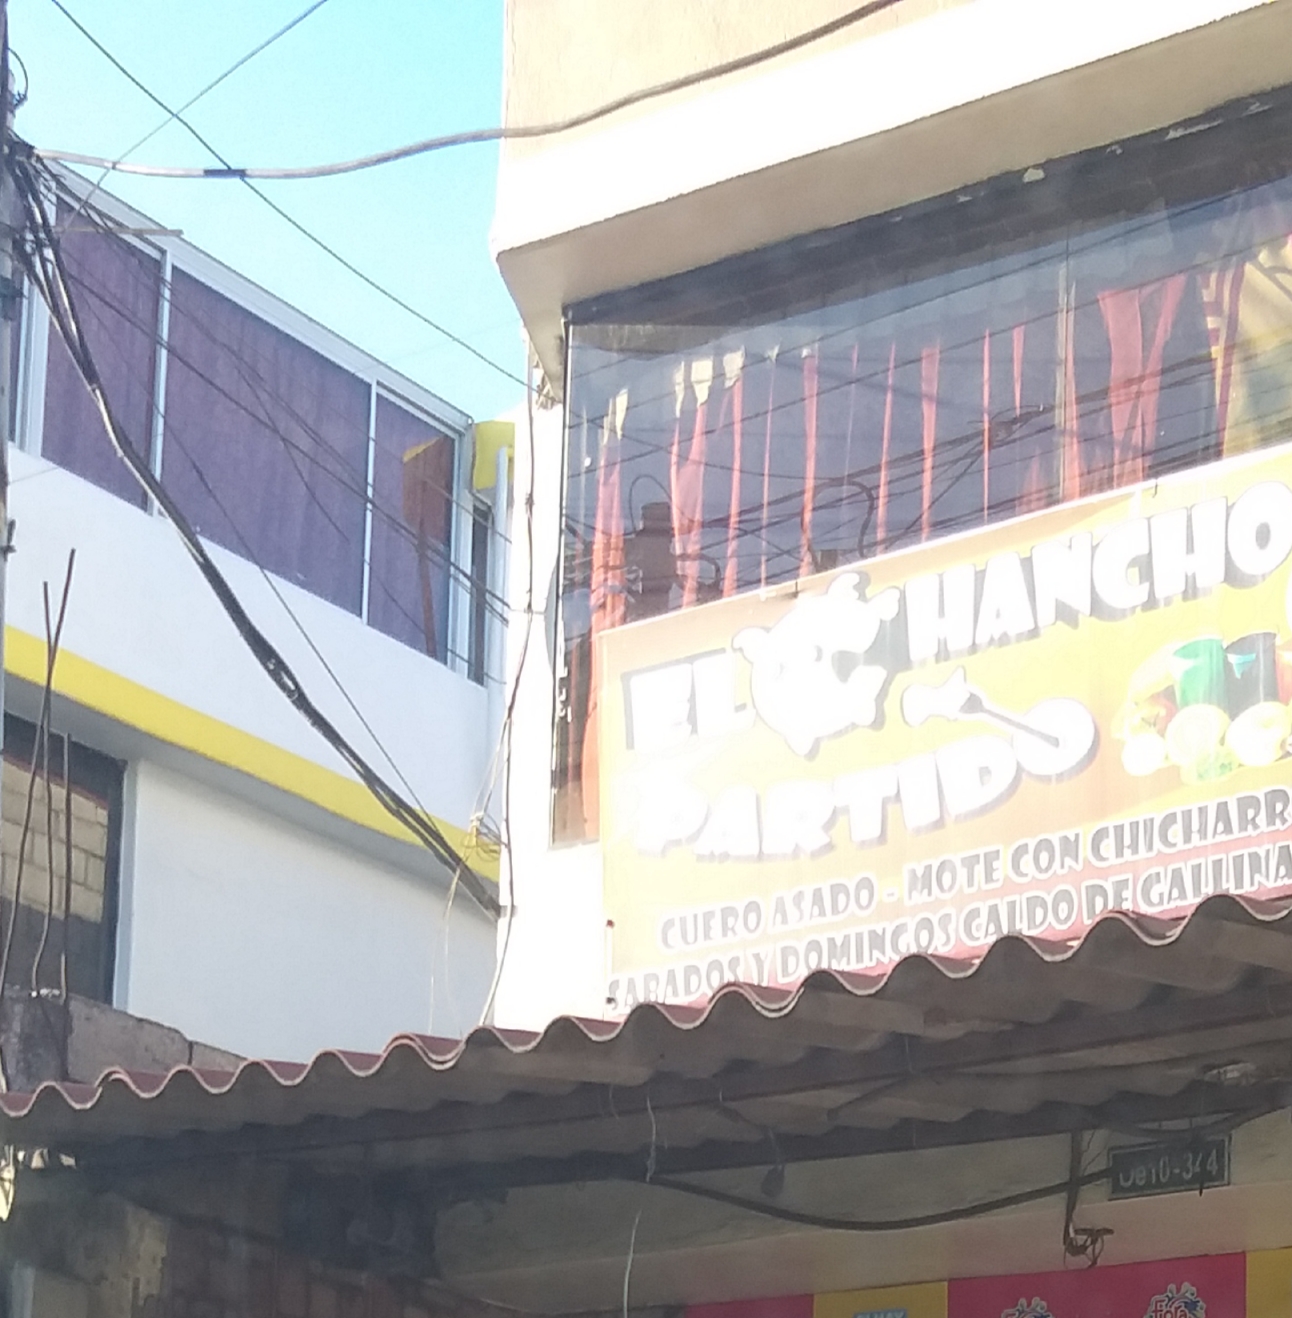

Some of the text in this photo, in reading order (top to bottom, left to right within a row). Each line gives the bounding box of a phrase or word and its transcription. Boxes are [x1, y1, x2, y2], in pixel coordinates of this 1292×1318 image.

[621, 647, 756, 752] EL
[624, 697, 1100, 863] PARTIDO
[606, 955, 742, 1012] SABADOS
[749, 950, 766, 986] Y
[779, 912, 953, 977] DOMINGOS
[963, 887, 1077, 942] CALDO
[1085, 875, 1132, 922] DE
[659, 898, 765, 951] CUERO
[771, 875, 876, 931] ASADO
[906, 849, 1001, 901] MOTE
[1009, 832, 1081, 880] CON
